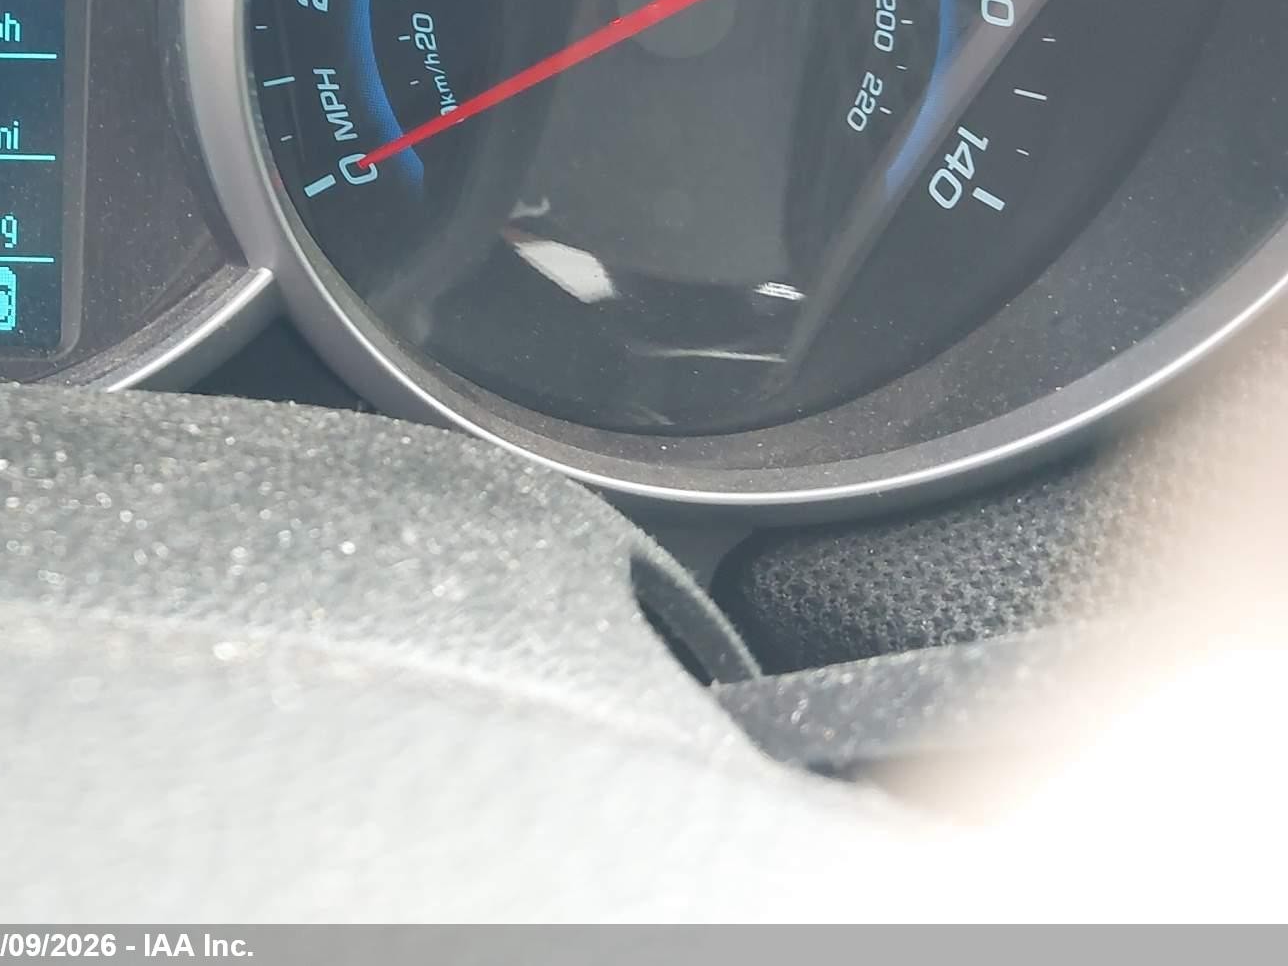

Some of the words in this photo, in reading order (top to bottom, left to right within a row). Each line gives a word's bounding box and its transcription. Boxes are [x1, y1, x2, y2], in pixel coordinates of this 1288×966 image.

[412, 13, 437, 51] 20
[313, 69, 358, 141] MPH
[847, 71, 883, 132] 220
[339, 154, 378, 184] 0
[928, 126, 988, 209] 140
